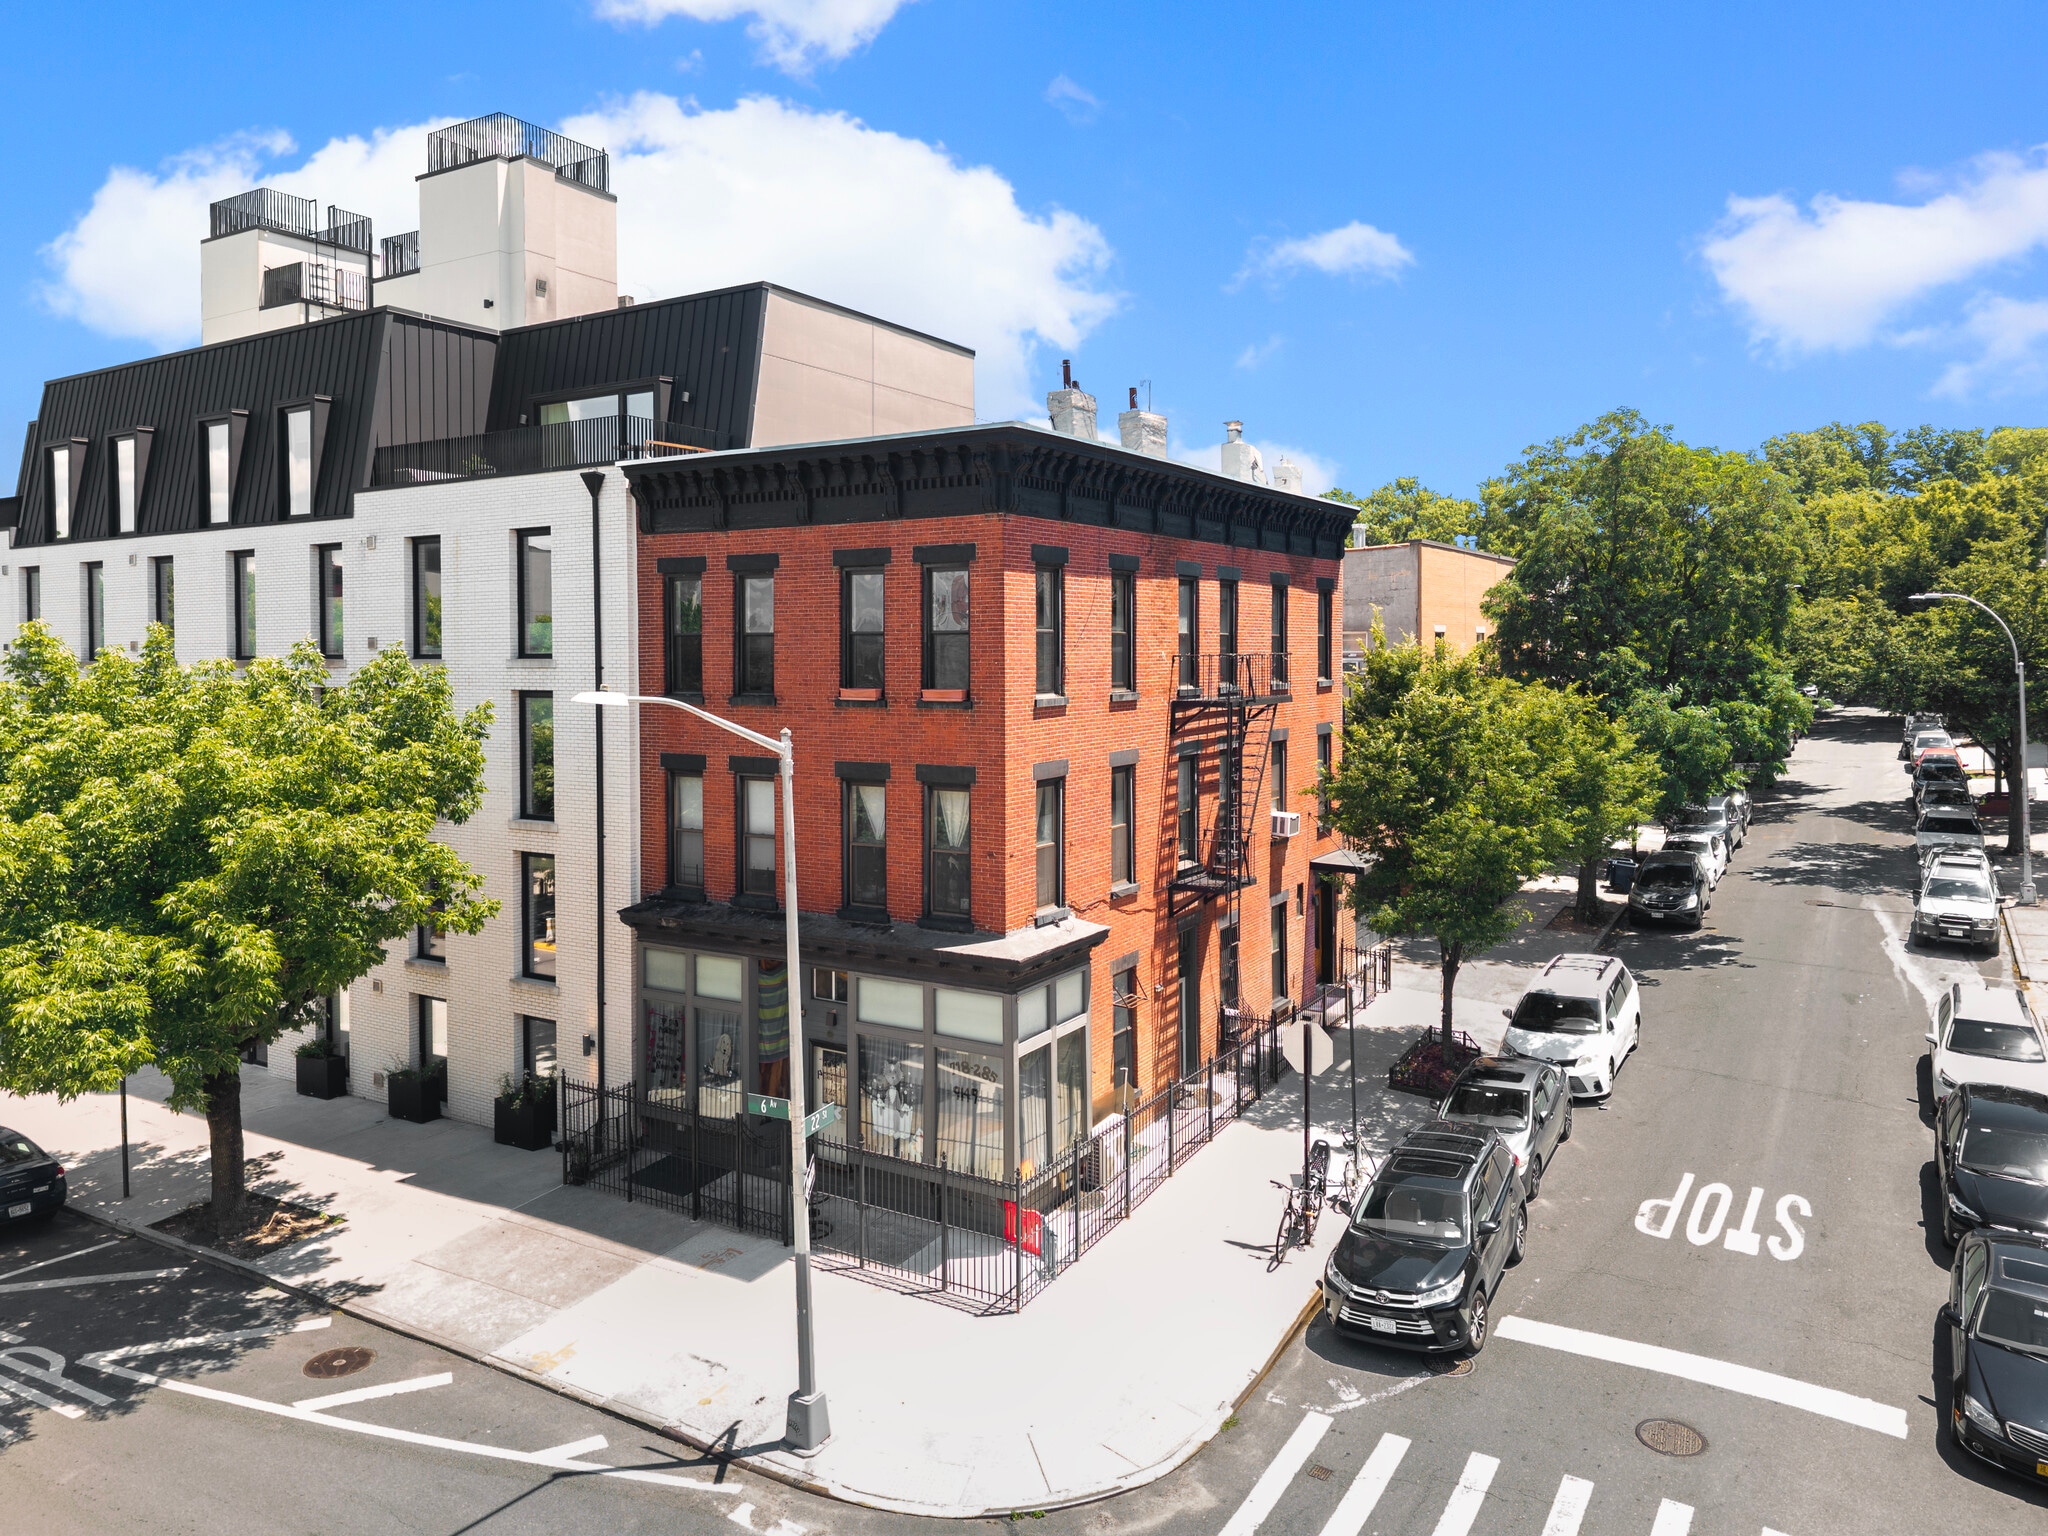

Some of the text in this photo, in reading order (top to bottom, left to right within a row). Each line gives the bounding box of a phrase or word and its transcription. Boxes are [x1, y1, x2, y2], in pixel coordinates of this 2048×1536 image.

[949, 1061, 998, 1083] 718-285
[761, 1099, 777, 1113] 6 Av
[953, 1086, 978, 1105] 9149
[811, 1110, 828, 1131] 22 St
[1634, 1172, 1812, 1261] STOP
